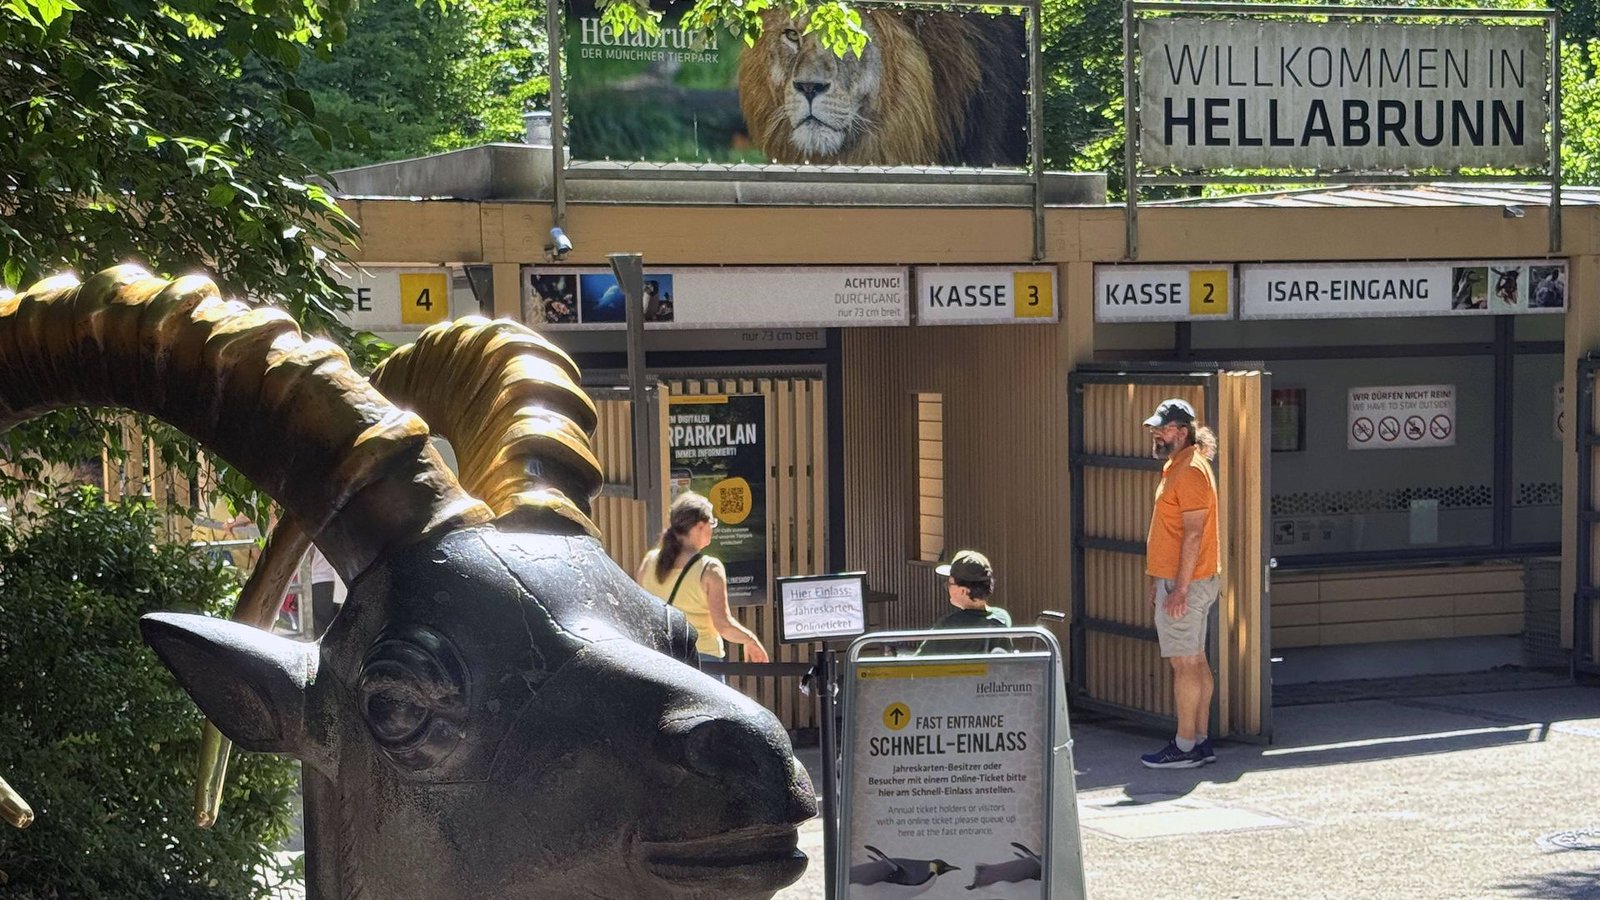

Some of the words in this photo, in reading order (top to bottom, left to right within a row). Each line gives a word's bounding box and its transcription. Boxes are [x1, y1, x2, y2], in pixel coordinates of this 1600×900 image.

[580, 17, 719, 50] Helabrun
[581, 48, 603, 59] DER
[605, 47, 665, 61] MÜNCHNER
[667, 51, 719, 63] TIERPARK
[1164, 43, 1469, 88] WILLKOMMEN
[1489, 48, 1525, 88] IN
[1164, 97, 1525, 147] HELLABRUNN
[845, 277, 900, 288] ACHTUNG!
[929, 285, 1007, 307] KASSE
[1027, 285, 1039, 306] 3
[1105, 282, 1182, 305] KASSE
[1202, 283, 1215, 304] 2
[1266, 278, 1429, 302] ISAR-EINGANG
[415, 288, 433, 312] 4
[834, 293, 900, 304] DURCHGANG
[838, 309, 852, 317] nur
[855, 307, 864, 317] 73
[866, 309, 879, 317] cm
[881, 307, 900, 317] breit
[741, 332, 759, 342] nur
[761, 331, 774, 341] 73
[776, 332, 793, 341] cm
[795, 330, 819, 341] breit
[1352, 391, 1370, 401] WIR
[1371, 390, 1403, 400] DÜRFEN
[1405, 390, 1428, 400] NICHT
[1430, 389, 1452, 399] REIN!
[1352, 402, 1365, 411] WE
[1367, 402, 1386, 411] HAVE
[1388, 401, 1398, 410] TO
[1399, 401, 1417, 410] STAY
[677, 414, 710, 424] DIGITALEN
[675, 449, 697, 458] IMMER
[791, 588, 811, 599] Hier
[815, 586, 852, 597] Einlass:
[795, 620, 852, 632] Onlineticket
[976, 682, 1033, 694] Hellabrunn
[916, 716, 943, 729] FAST
[947, 715, 1004, 729] ENTRANCE
[869, 731, 1027, 757] SCHNELL-EINLASS
[893, 763, 981, 774] Jahreskarten-Besitzer
[983, 762, 1002, 770] oder
[868, 776, 905, 785] Besucher
[907, 776, 921, 785] mit
[924, 776, 948, 785] einem
[951, 773, 1004, 783] Online-Ticket
[1006, 773, 1027, 782] bitte
[878, 788, 894, 797] hier
[911, 786, 973, 797] Schnell-Einlass
[975, 786, 1015, 795] anstellen.
[888, 805, 914, 814] Annual
[916, 804, 937, 813] ticket
[939, 804, 966, 813] holders
[979, 803, 1005, 812] visitors
[877, 817, 895, 826] with
[907, 817, 930, 825] online
[932, 816, 953, 825] ticket
[955, 815, 979, 825] please
[980, 815, 1004, 825] queue
[1006, 815, 1016, 824] up
[926, 827, 940, 836] the
[941, 826, 957, 836] fast
